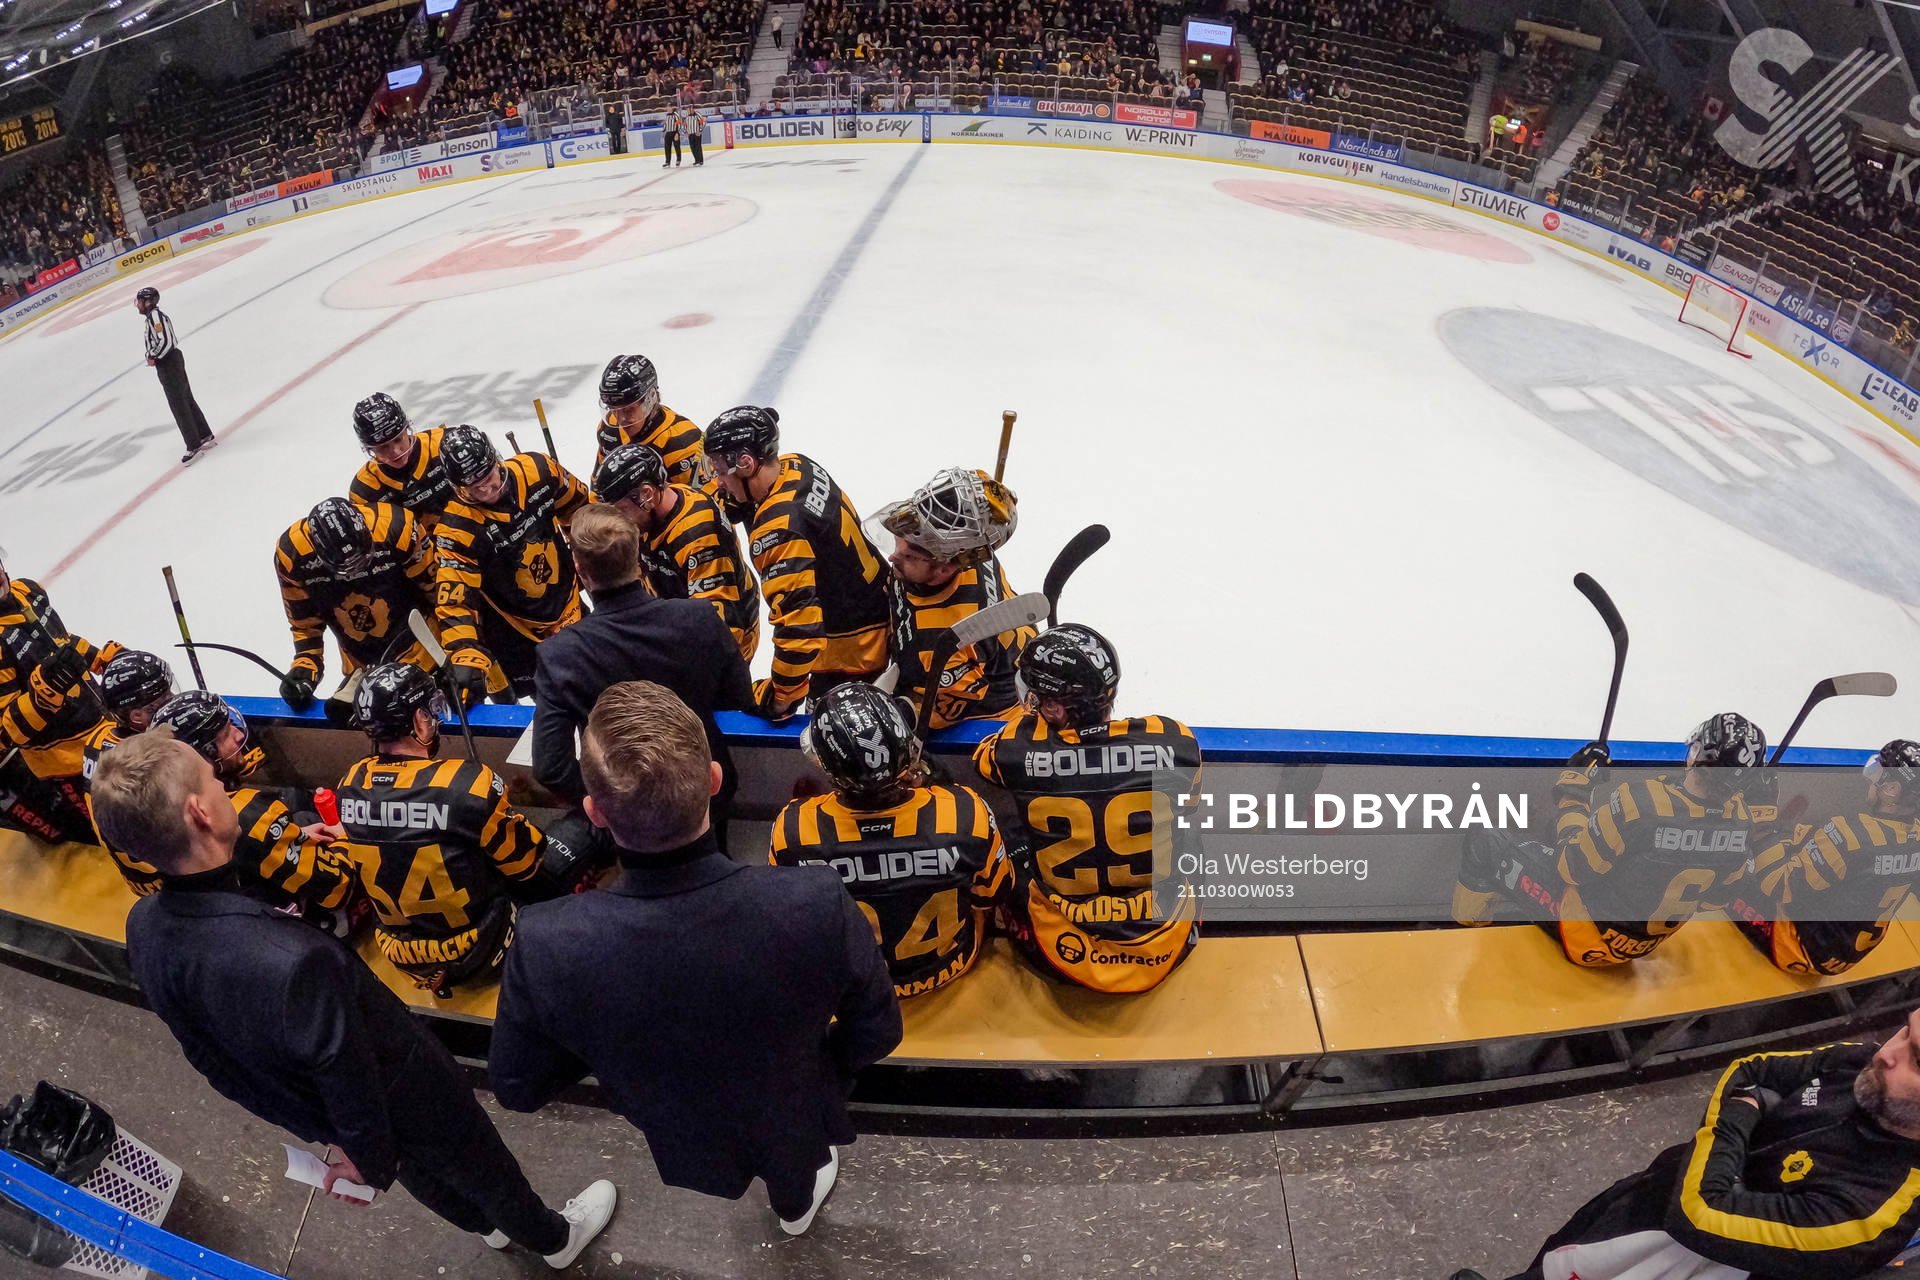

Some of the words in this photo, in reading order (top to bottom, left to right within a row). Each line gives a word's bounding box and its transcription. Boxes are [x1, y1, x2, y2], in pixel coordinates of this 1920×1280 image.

[35, 119, 59, 140] 2014
[742, 121, 824, 140] BOLIDEN
[837, 118, 874, 132] tieto
[1054, 127, 1112, 141] KAIDING
[2, 130, 27, 152] 2013
[440, 138, 489, 156] Henson
[1263, 131, 1314, 145] MAXULIN
[1338, 139, 1384, 158] Norrlands
[1385, 149, 1399, 160] Bil
[341, 172, 397, 193] SKIDSTAHUS
[1380, 169, 1450, 194] Handelsbanken
[121, 244, 165, 268] engcon
[1781, 294, 1830, 330] 4Sign.se
[1792, 333, 1840, 368] TEXOR
[1892, 404, 1913, 421] group
[437, 582, 465, 605] 64
[1033, 645, 1054, 664] SK
[1103, 666, 1114, 678] 29
[408, 690, 425, 704] CCM
[1038, 682, 1060, 693] CCM
[1079, 725, 1108, 737] CCM
[855, 724, 890, 769] SK
[1033, 744, 1176, 778] BOLIDEN
[371, 775, 396, 783] CCM
[12, 803, 61, 839] REPAY
[345, 798, 449, 830] BOLIDEN
[860, 823, 892, 834] CCM
[1027, 790, 1174, 896] 29
[316, 845, 340, 877] 15
[1646, 868, 1716, 936] 6
[1089, 949, 1174, 968] Contractor
